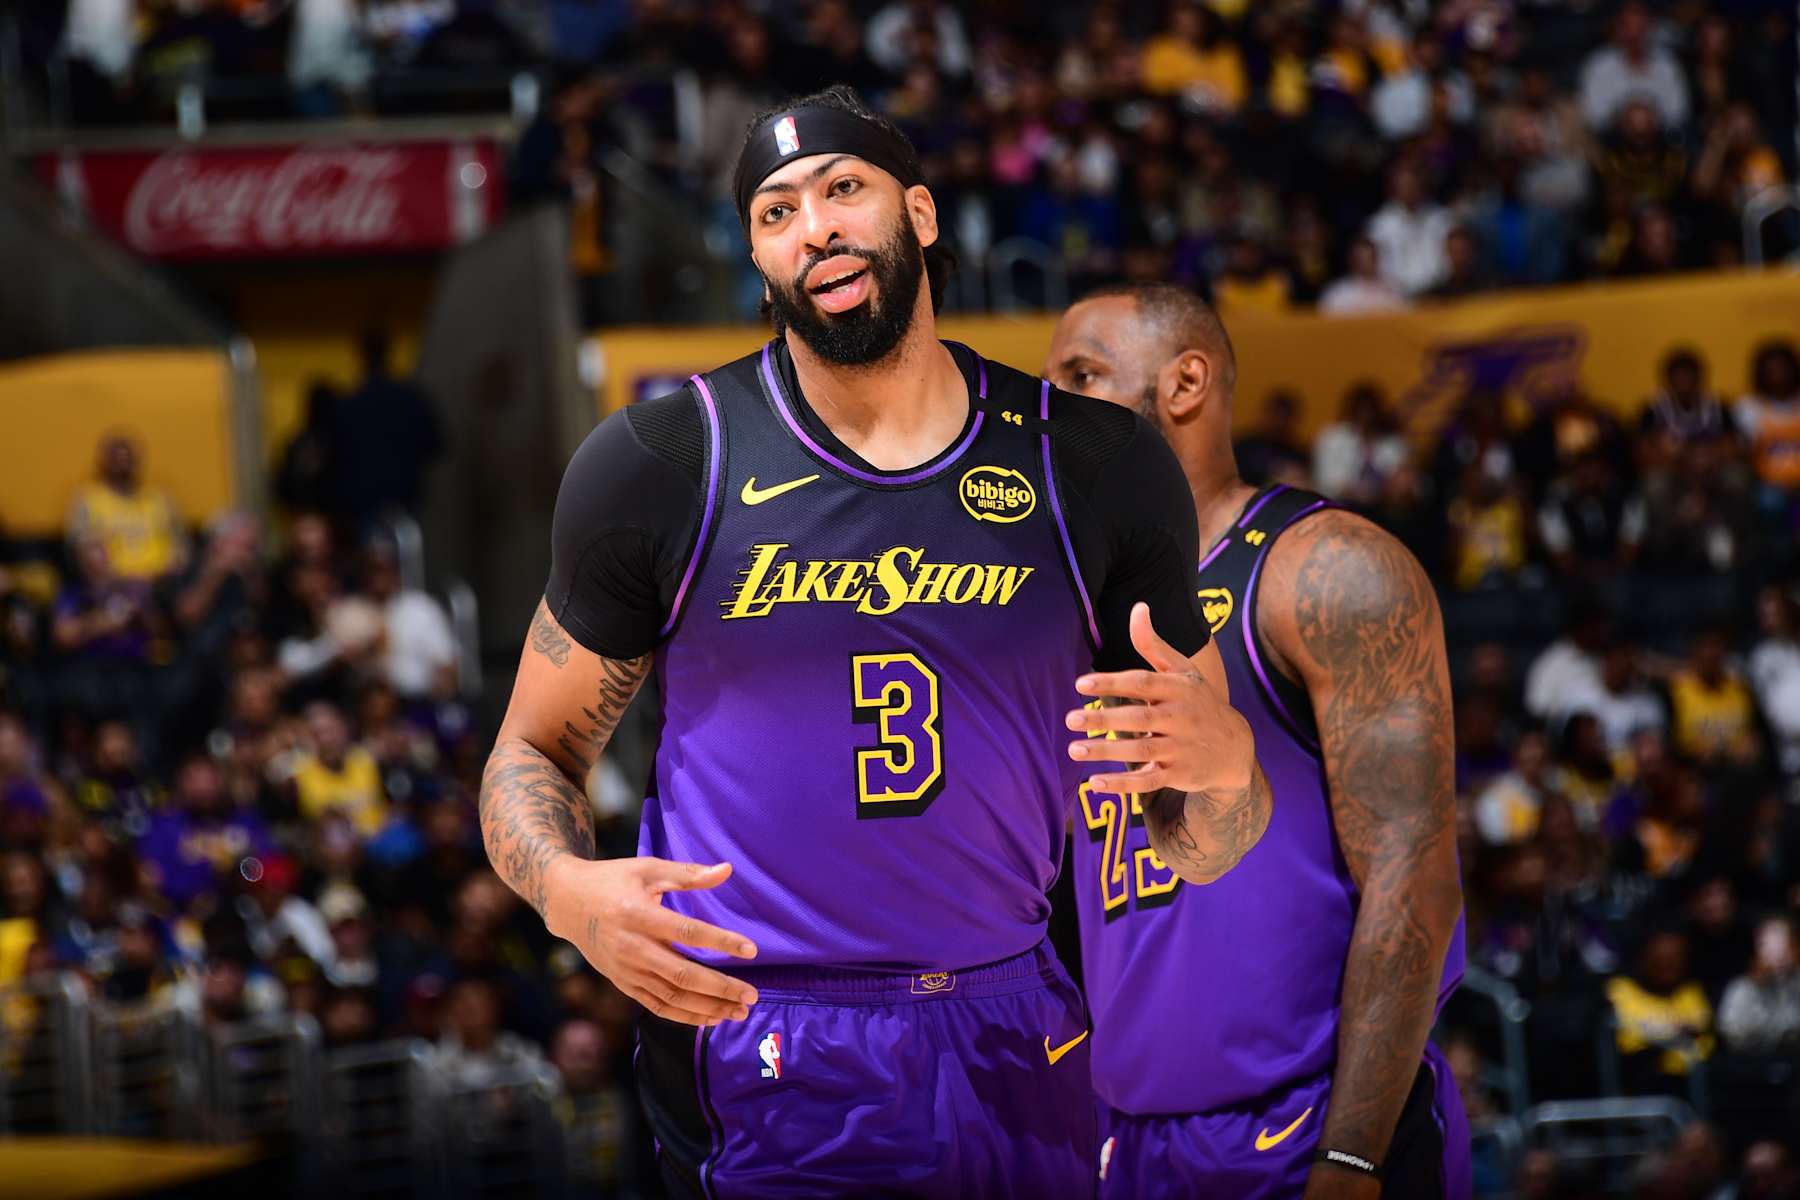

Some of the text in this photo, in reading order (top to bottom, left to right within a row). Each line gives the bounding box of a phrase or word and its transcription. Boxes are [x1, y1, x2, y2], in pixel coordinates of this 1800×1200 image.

[966, 479, 1031, 508] bibigo
[977, 498, 1005, 511] 비비고
[852, 652, 943, 806] 3
